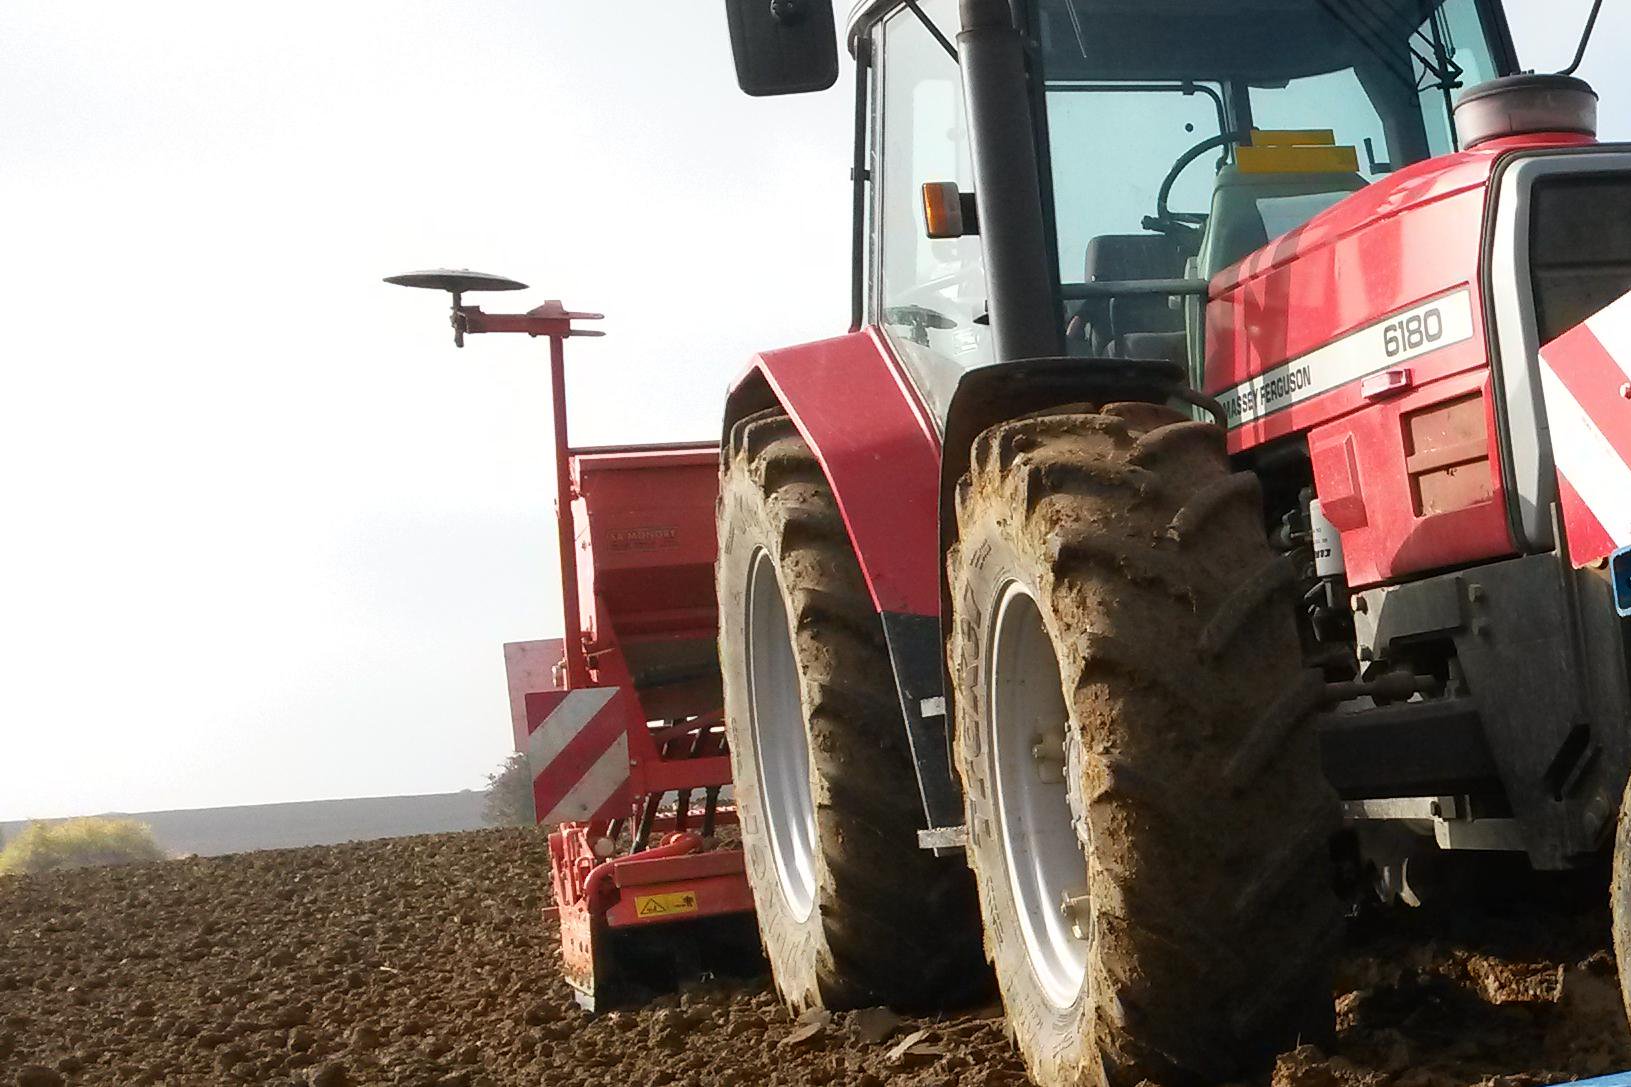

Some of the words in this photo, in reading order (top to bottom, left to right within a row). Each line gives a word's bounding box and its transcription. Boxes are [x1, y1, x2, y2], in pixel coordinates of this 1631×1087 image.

[1383, 308, 1442, 357] 6180
[1222, 388, 1259, 418] MASSEY
[1260, 365, 1311, 406] FERGUSON
